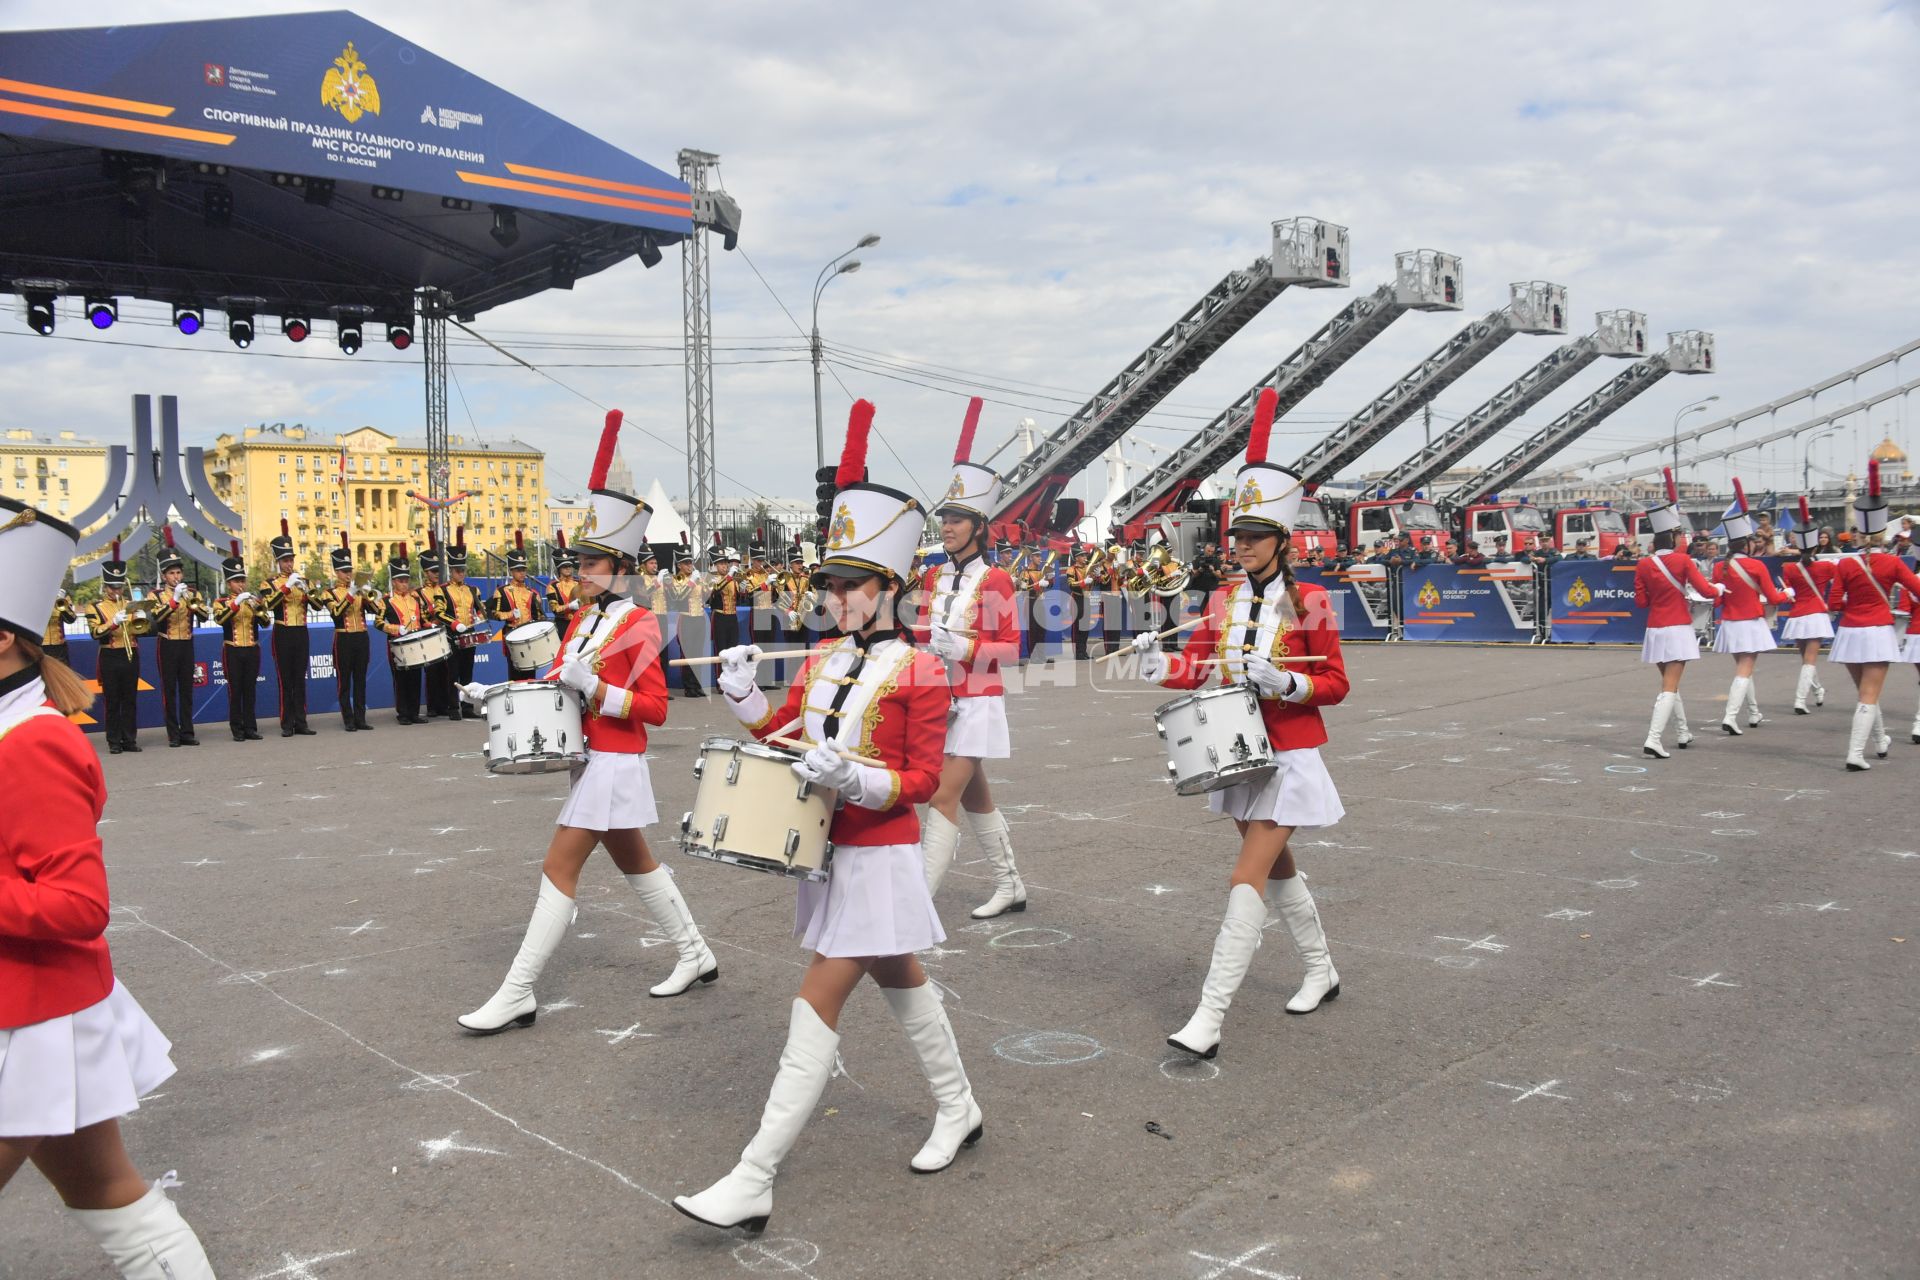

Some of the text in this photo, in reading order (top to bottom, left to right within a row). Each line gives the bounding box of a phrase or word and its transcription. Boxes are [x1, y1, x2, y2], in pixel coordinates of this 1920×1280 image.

[439, 107, 483, 126] МОСКОВСКИЙ
[439, 117, 460, 131] СПОРТ
[203, 107, 485, 164] СПОРТИВНЫЙ ПРАЗДНИК ГЛАВНОГО УПРАВЛЕНИЯ
[312, 137, 391, 160] МЧС РОССИИ
[327, 153, 339, 162] ПО
[346, 156, 377, 168] МОСКВЕ
[1594, 589, 1616, 599] МЧС
